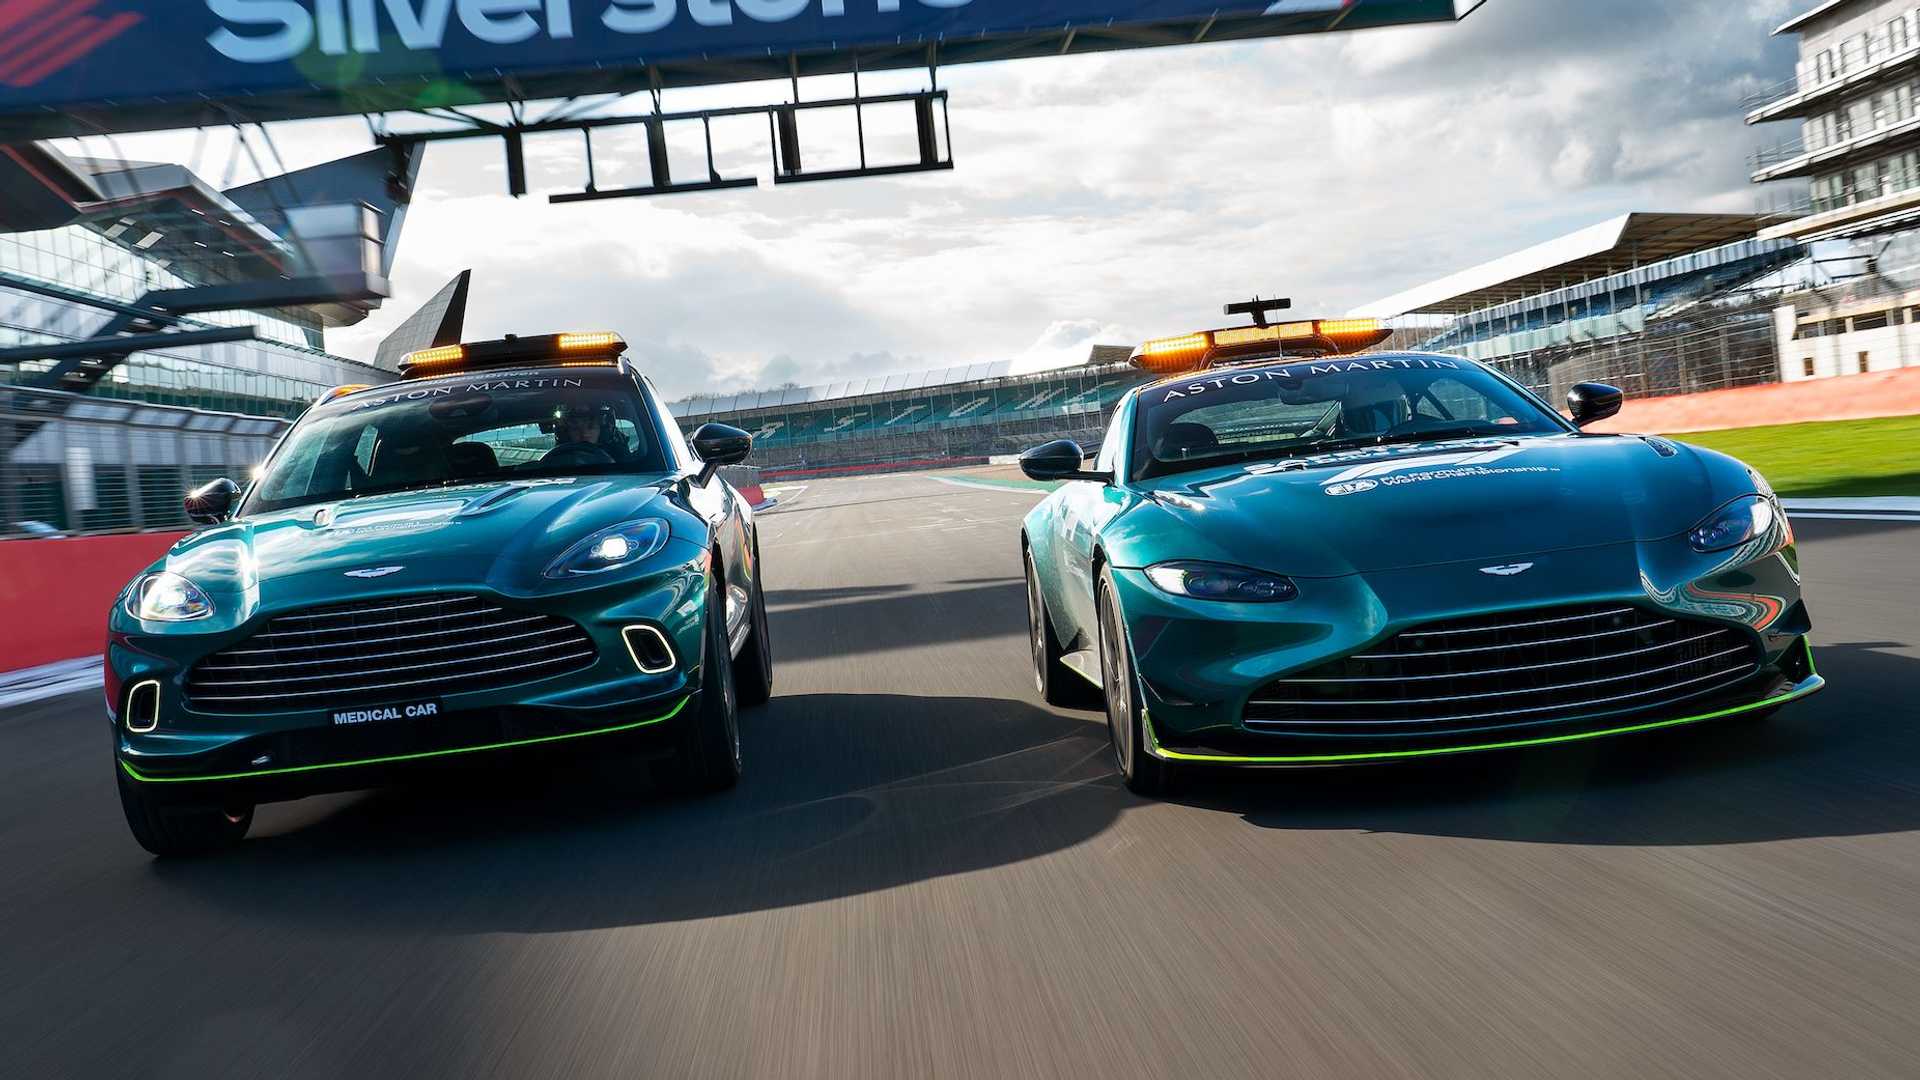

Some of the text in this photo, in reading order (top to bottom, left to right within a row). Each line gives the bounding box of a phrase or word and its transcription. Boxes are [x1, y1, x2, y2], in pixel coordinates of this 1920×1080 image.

[352, 378, 583, 410] ASTON MARTIN
[1163, 359, 1459, 402] ASTON MARTIN
[334, 703, 437, 725] MEDICAL CAR
